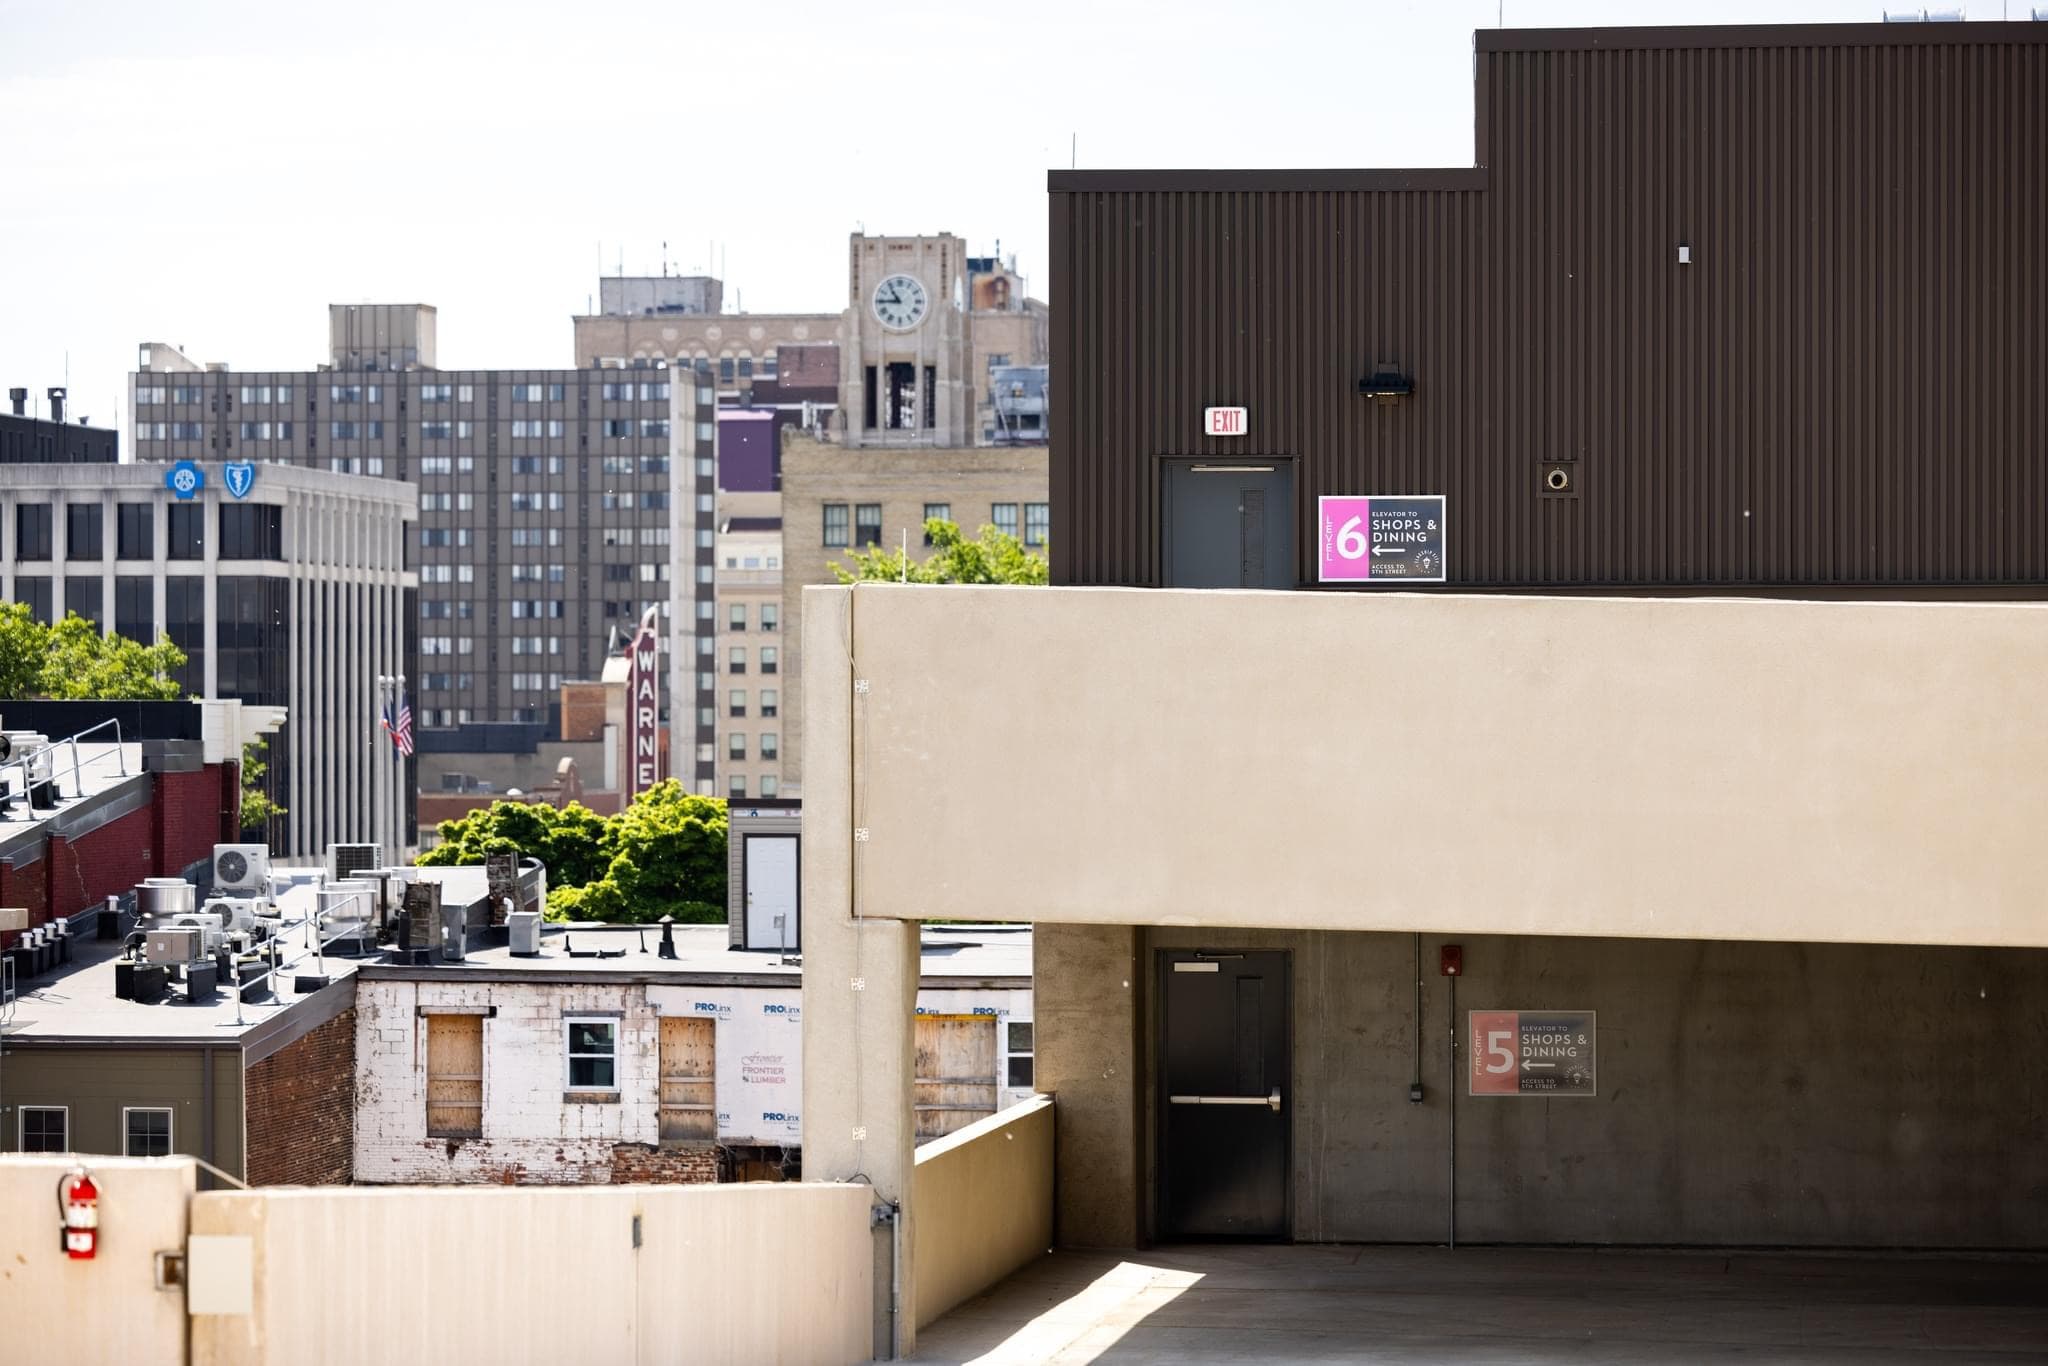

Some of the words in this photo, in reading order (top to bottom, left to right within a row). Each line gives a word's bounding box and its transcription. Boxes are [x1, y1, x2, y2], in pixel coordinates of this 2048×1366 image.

[1213, 410, 1241, 432] EXIT
[1372, 519, 1421, 530] SHOPS
[1427, 519, 1437, 530] &
[1325, 515, 1334, 562] LEVEL
[1336, 515, 1367, 560] 6
[1373, 532, 1427, 543] DINING
[638, 651, 654, 785] WARNE
[695, 1002, 731, 1012] PROLinx
[1522, 1034, 1571, 1045] SHOPS
[1577, 1034, 1587, 1045] &
[1474, 1029, 1482, 1076] LEVEL
[1486, 1031, 1514, 1074] 5
[1523, 1046, 1577, 1057] DINING
[742, 1066, 785, 1075] FRONTIER
[751, 1076, 786, 1084] LUMBER
[763, 1112, 800, 1122] PROLinx
